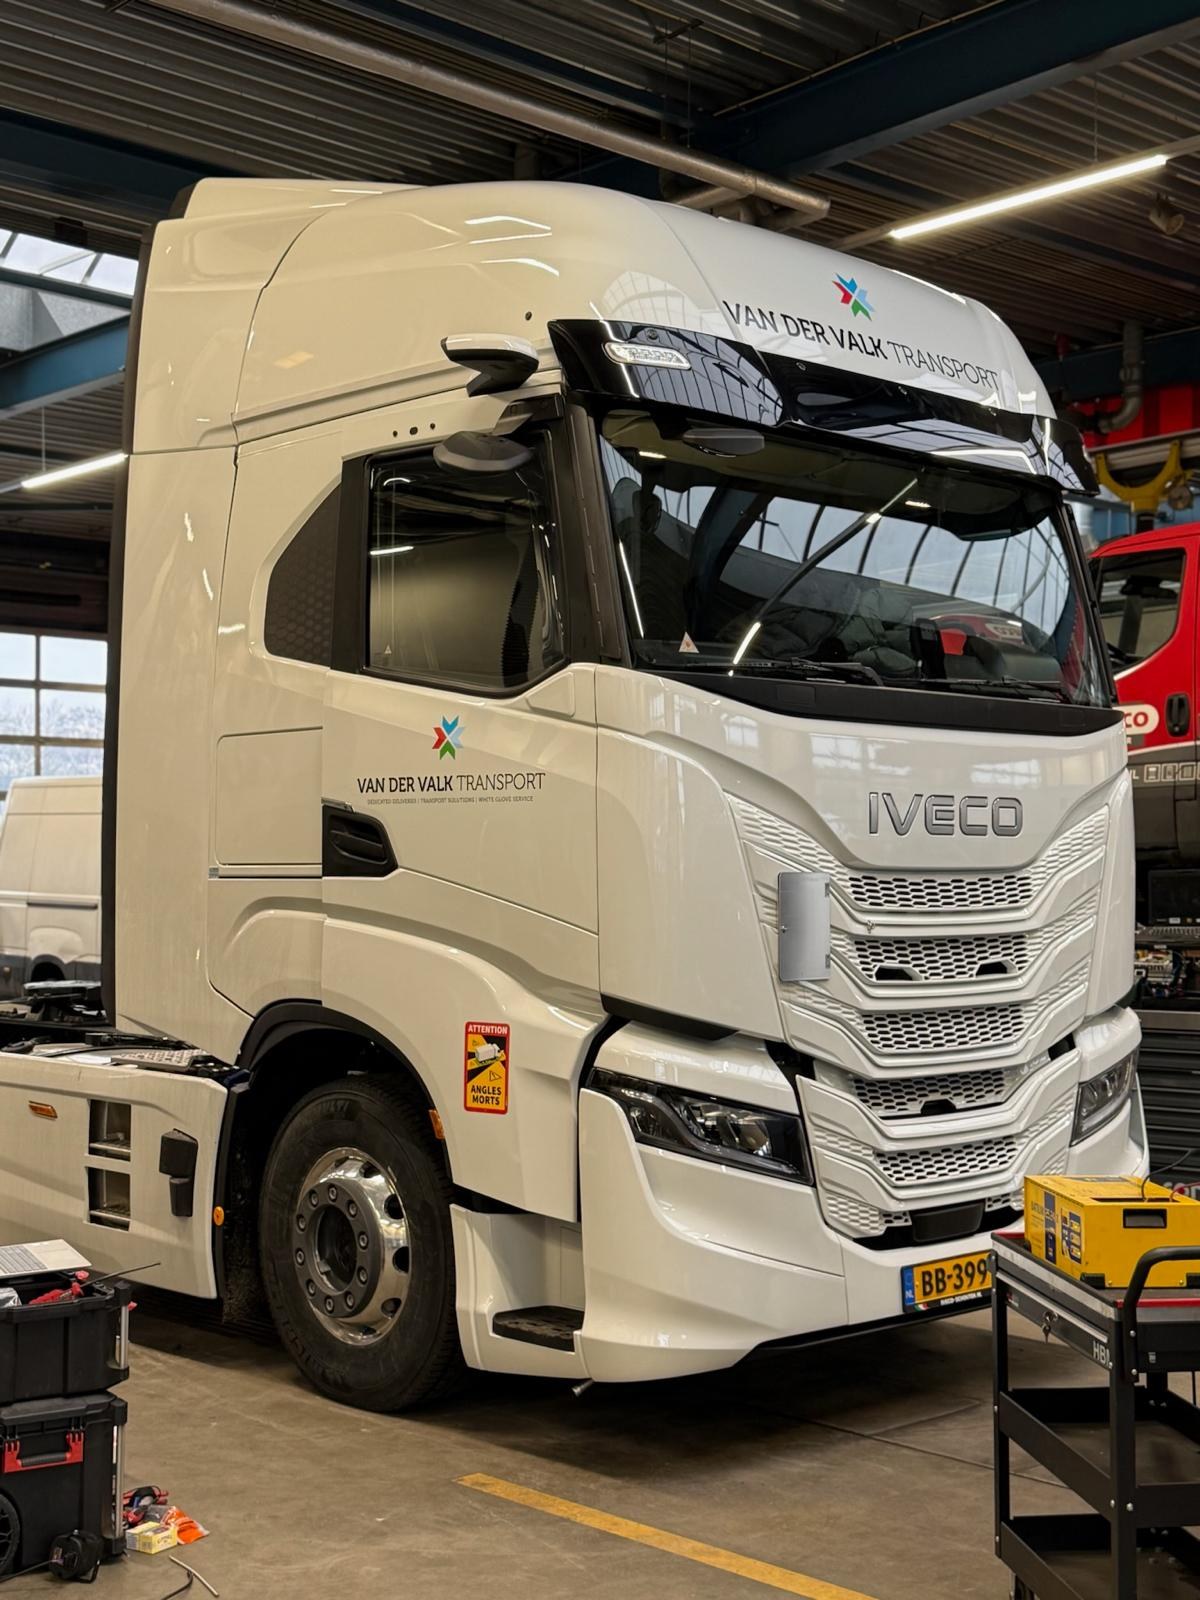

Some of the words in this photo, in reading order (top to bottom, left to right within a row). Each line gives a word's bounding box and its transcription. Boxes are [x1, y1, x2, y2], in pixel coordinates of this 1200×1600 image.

[723, 301, 778, 334] VAN
[781, 313, 828, 346] DER
[828, 325, 888, 361] VALK
[887, 341, 1001, 391] TRANSPORT
[357, 777, 385, 793] VAN
[389, 776, 415, 792] DER
[418, 775, 453, 792] VALK
[457, 773, 546, 791] TRANSPORT
[868, 791, 1024, 837] IVECO
[468, 1024, 508, 1035] ATTENTION
[471, 1085, 502, 1096] ANGLES
[472, 1095, 500, 1106] MORTS
